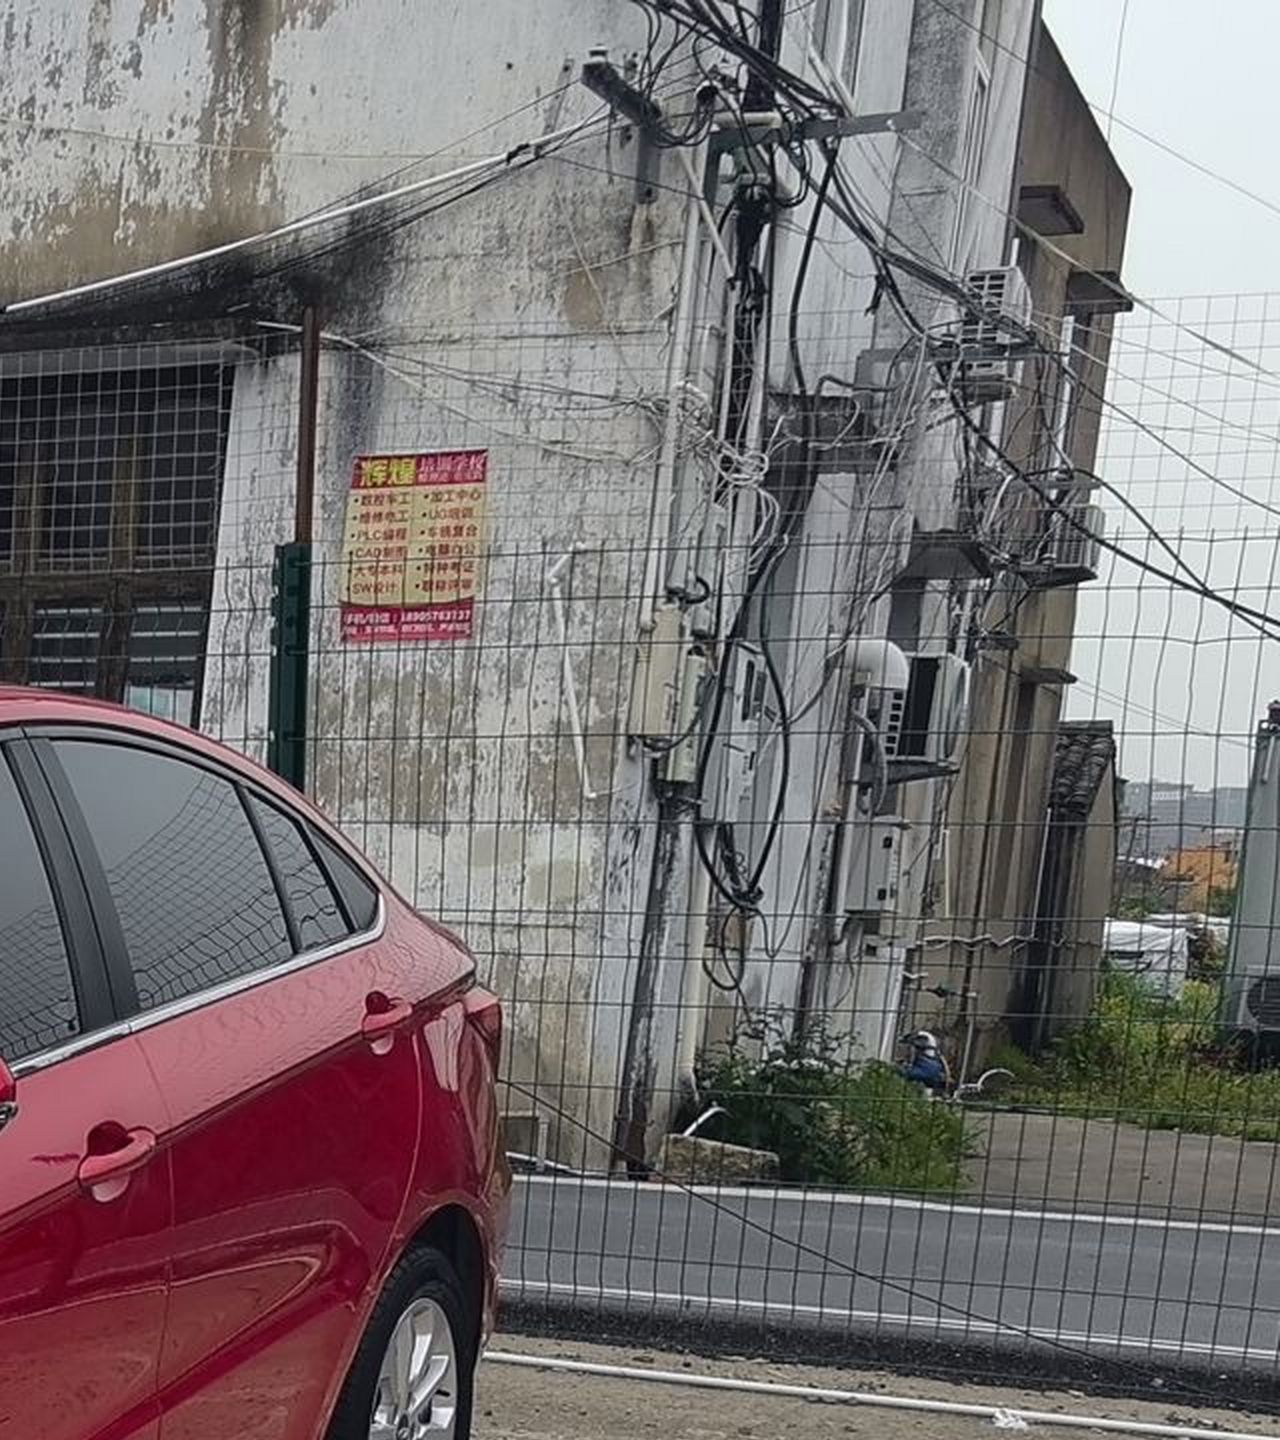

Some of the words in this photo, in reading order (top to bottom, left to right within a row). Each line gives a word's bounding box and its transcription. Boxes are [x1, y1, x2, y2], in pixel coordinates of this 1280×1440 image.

[360, 456, 416, 487] 辉煌
[430, 488, 481, 502] 加工中心
[357, 527, 407, 541] PLC编程
